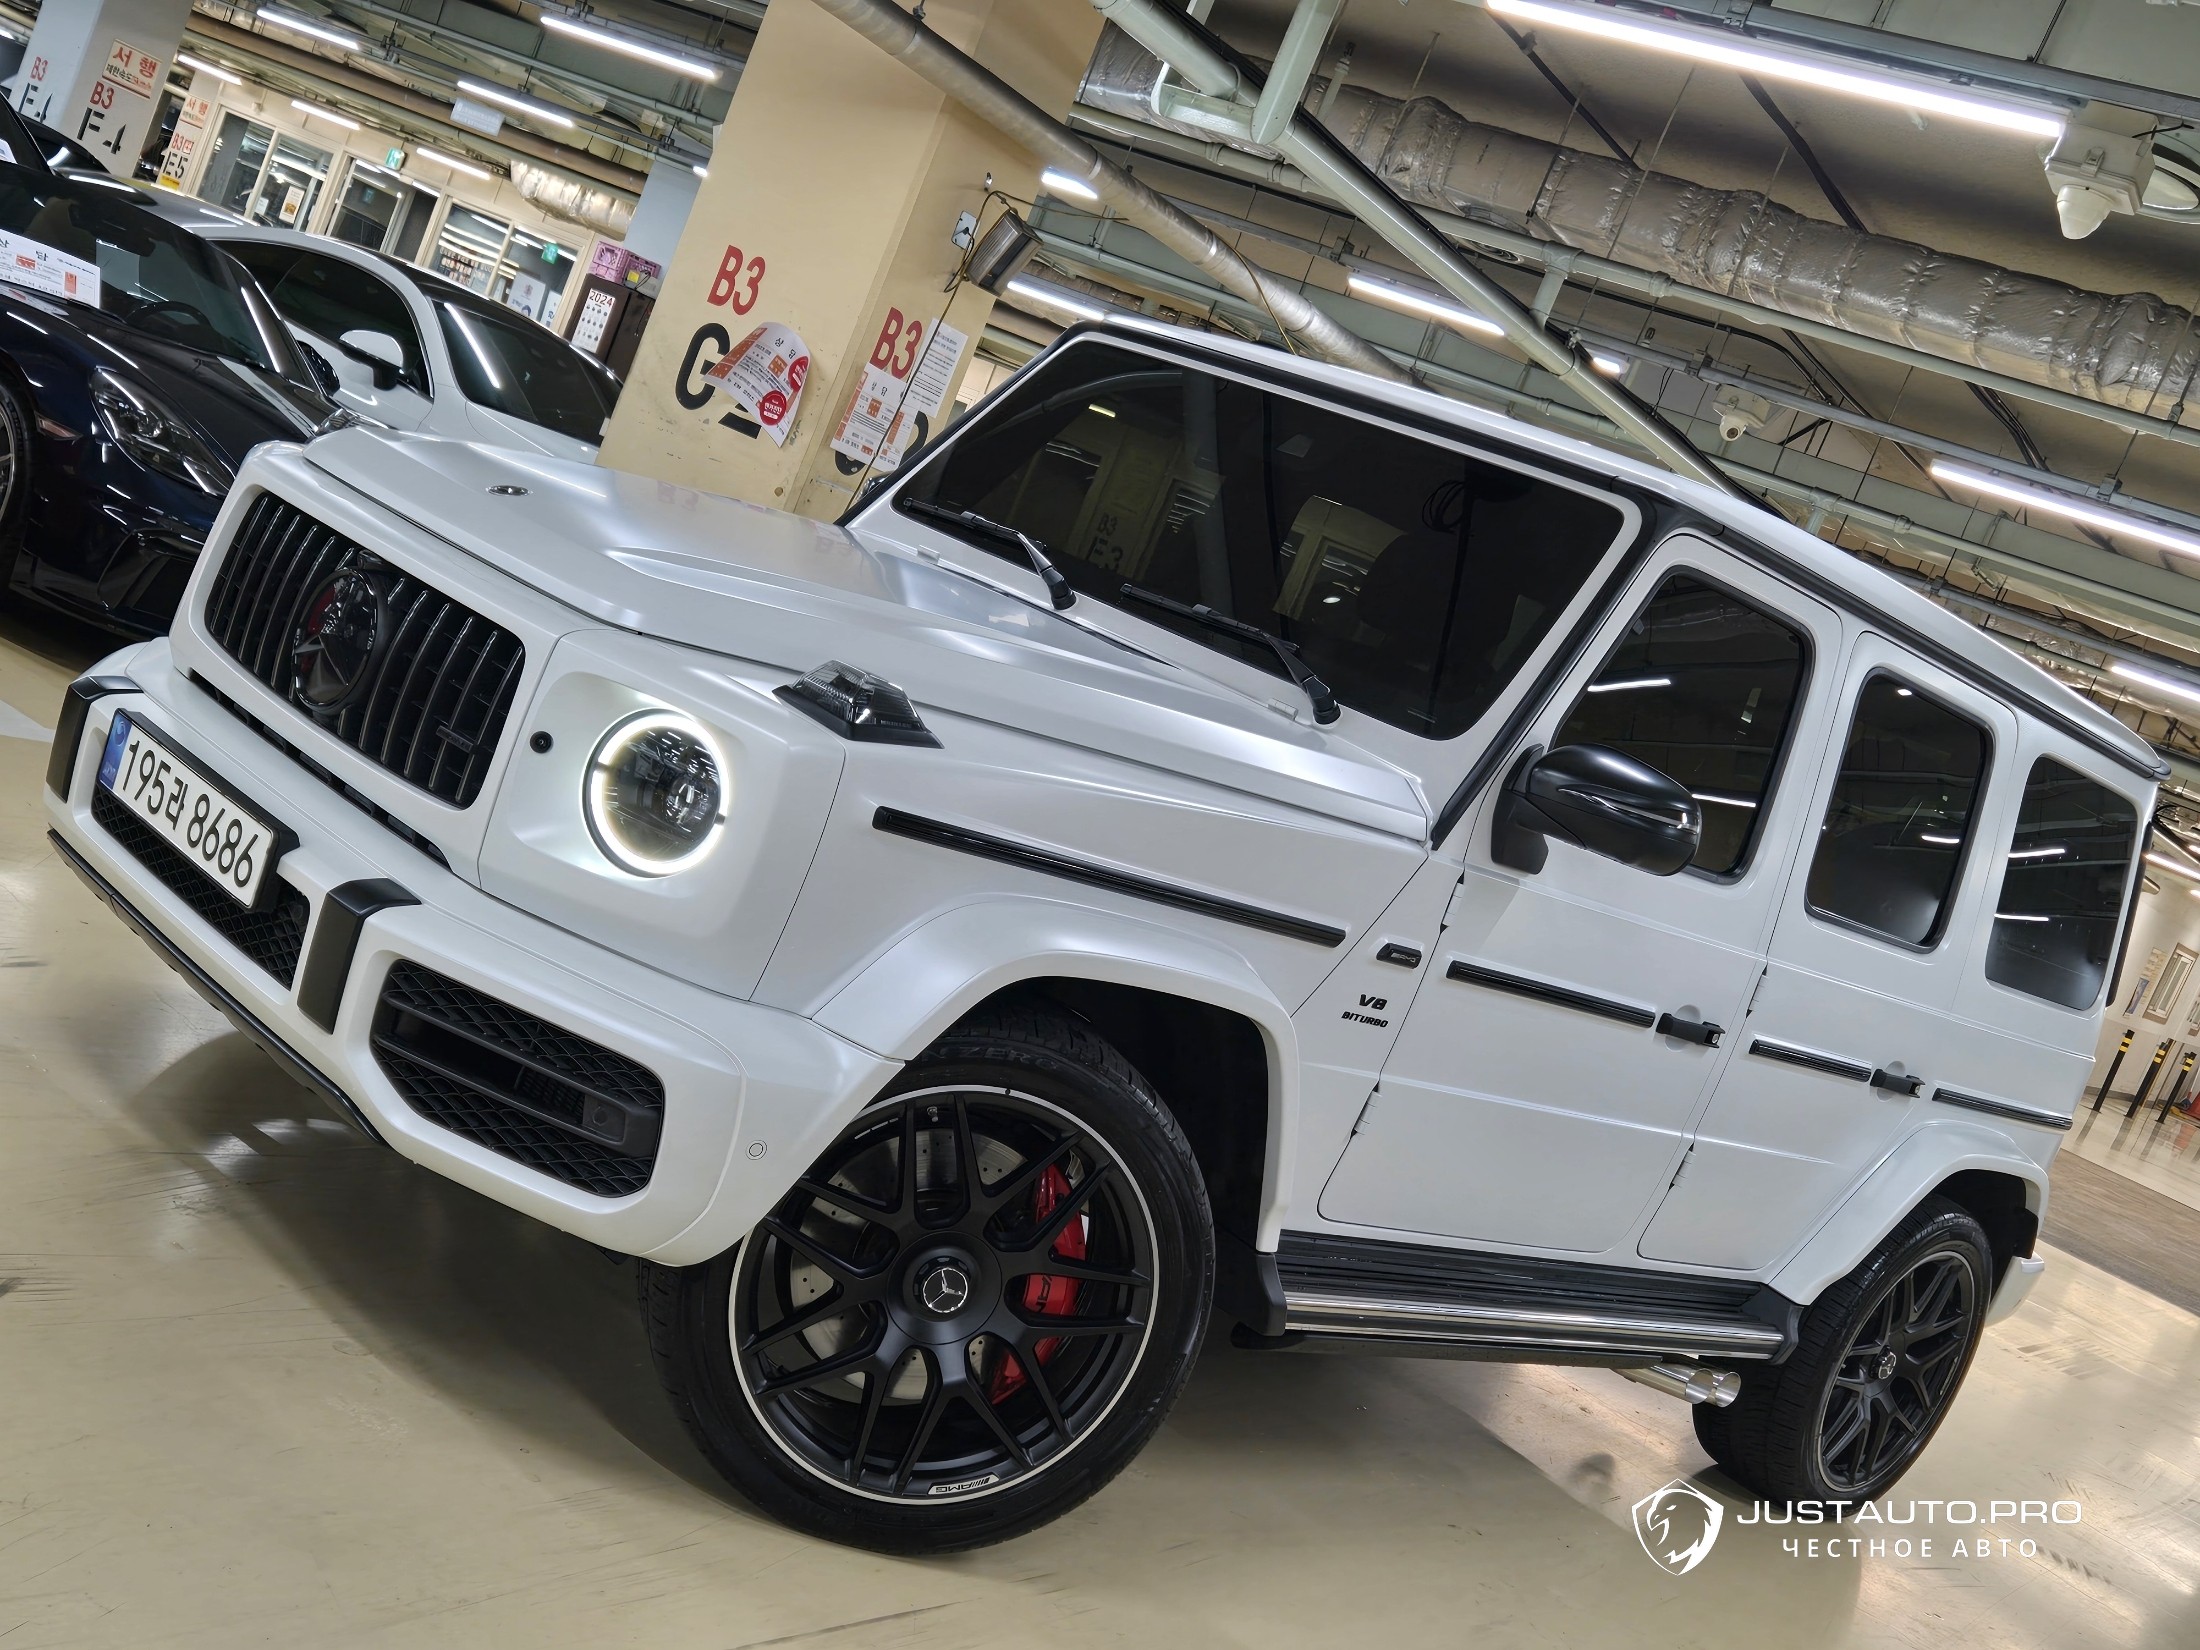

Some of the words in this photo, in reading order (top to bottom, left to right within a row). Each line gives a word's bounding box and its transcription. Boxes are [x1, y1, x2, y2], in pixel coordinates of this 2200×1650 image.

[30, 56, 48, 81] B3
[113, 46, 132, 68] 서
[139, 56, 157, 79] 행
[90, 81, 114, 109] B3
[163, 151, 189, 179] E5
[707, 244, 766, 315] B3
[589, 290, 613, 307] 2024
[870, 306, 923, 379] B3
[123, 740, 188, 831] 195라
[186, 793, 259, 888] 8686
[1359, 994, 1388, 1010] V8
[1341, 1011, 1389, 1027] BITURBO
[935, 1482, 973, 1493] AMG
